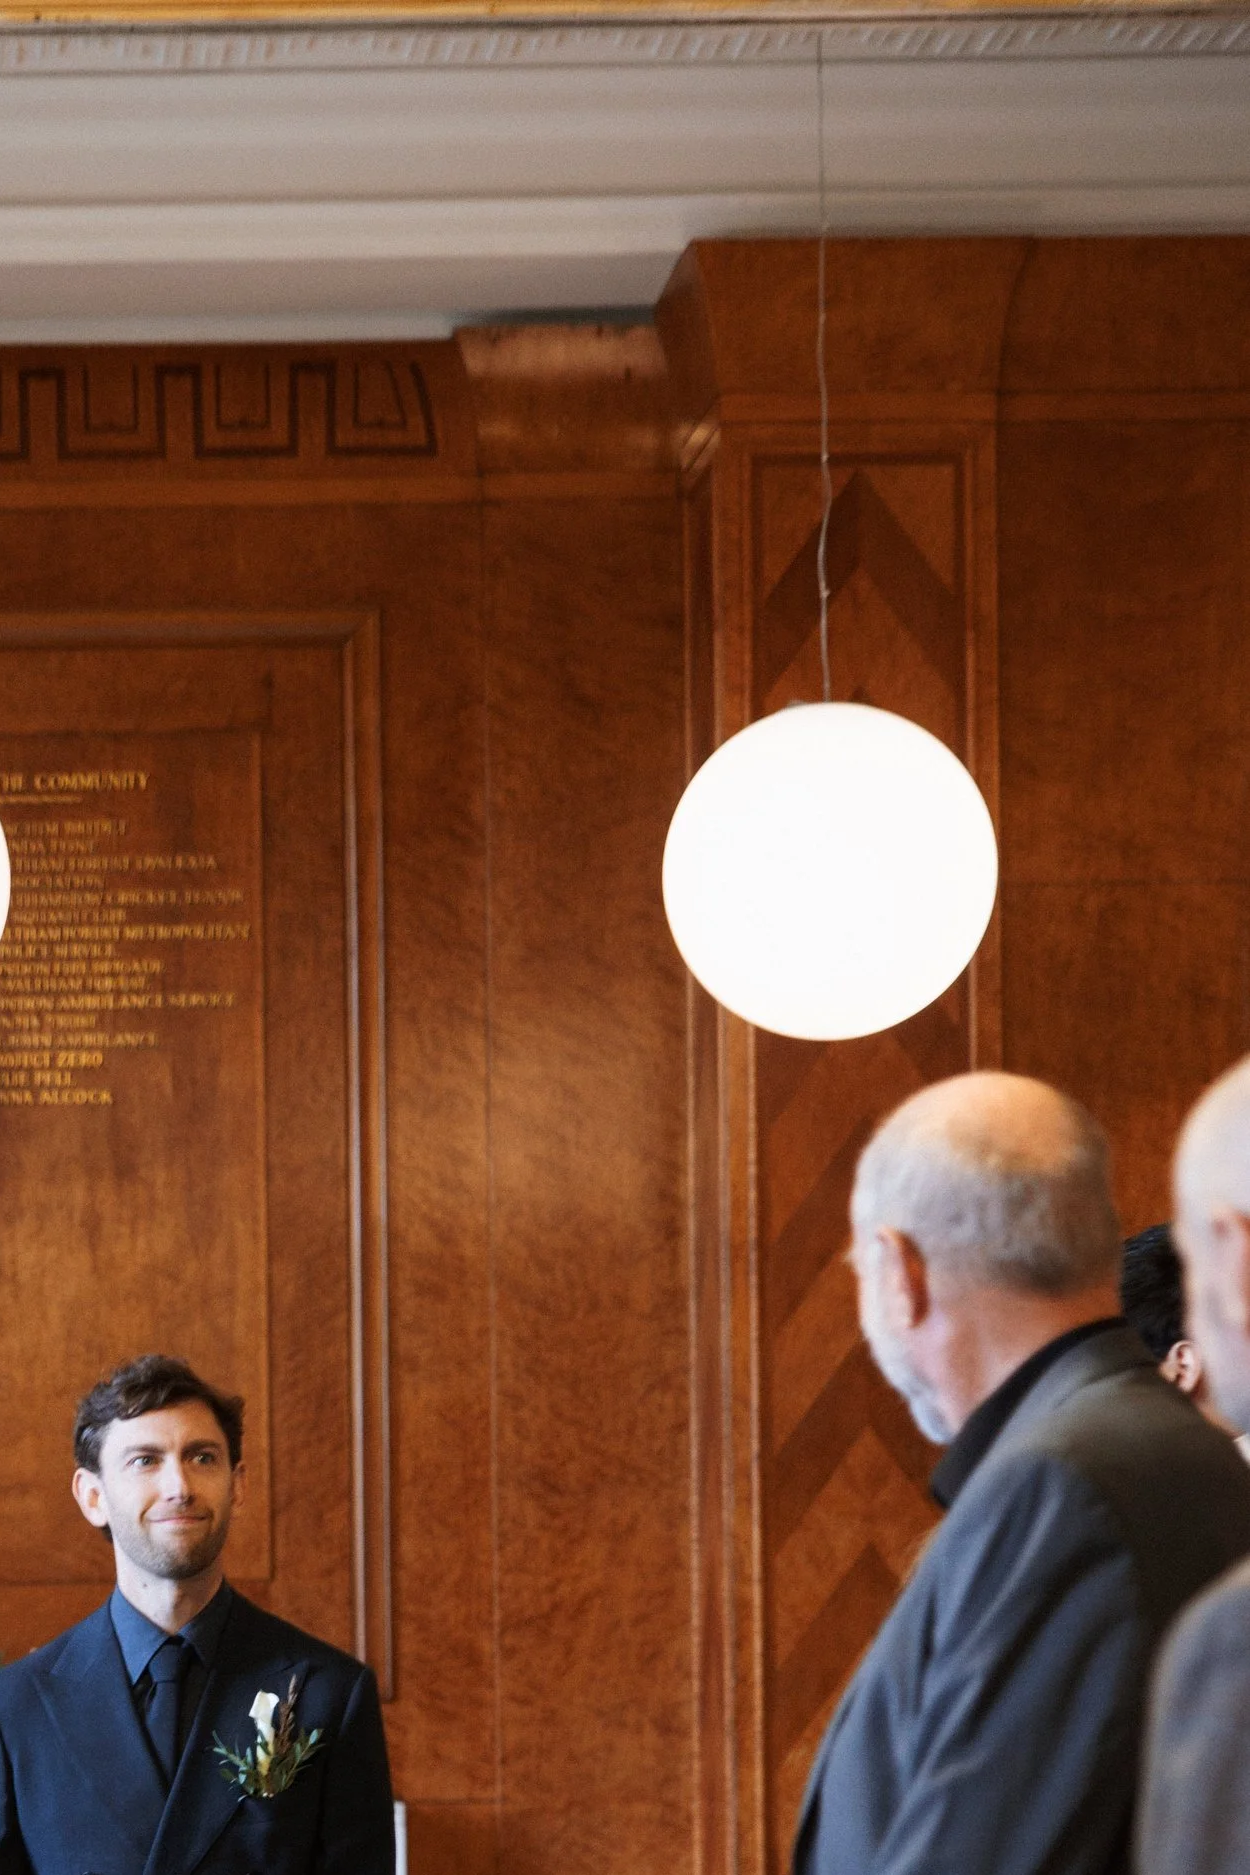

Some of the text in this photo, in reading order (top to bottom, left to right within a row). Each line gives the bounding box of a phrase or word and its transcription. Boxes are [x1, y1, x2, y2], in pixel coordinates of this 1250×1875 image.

[34, 769, 148, 791] COMMUNITY
[124, 922, 250, 940] METROPOLITAN
[57, 993, 163, 1009] AMBULANCE
[55, 1032, 157, 1047] AMBULANCE
[55, 1050, 104, 1067] ZERO
[39, 1088, 113, 1105] ALCOCK
